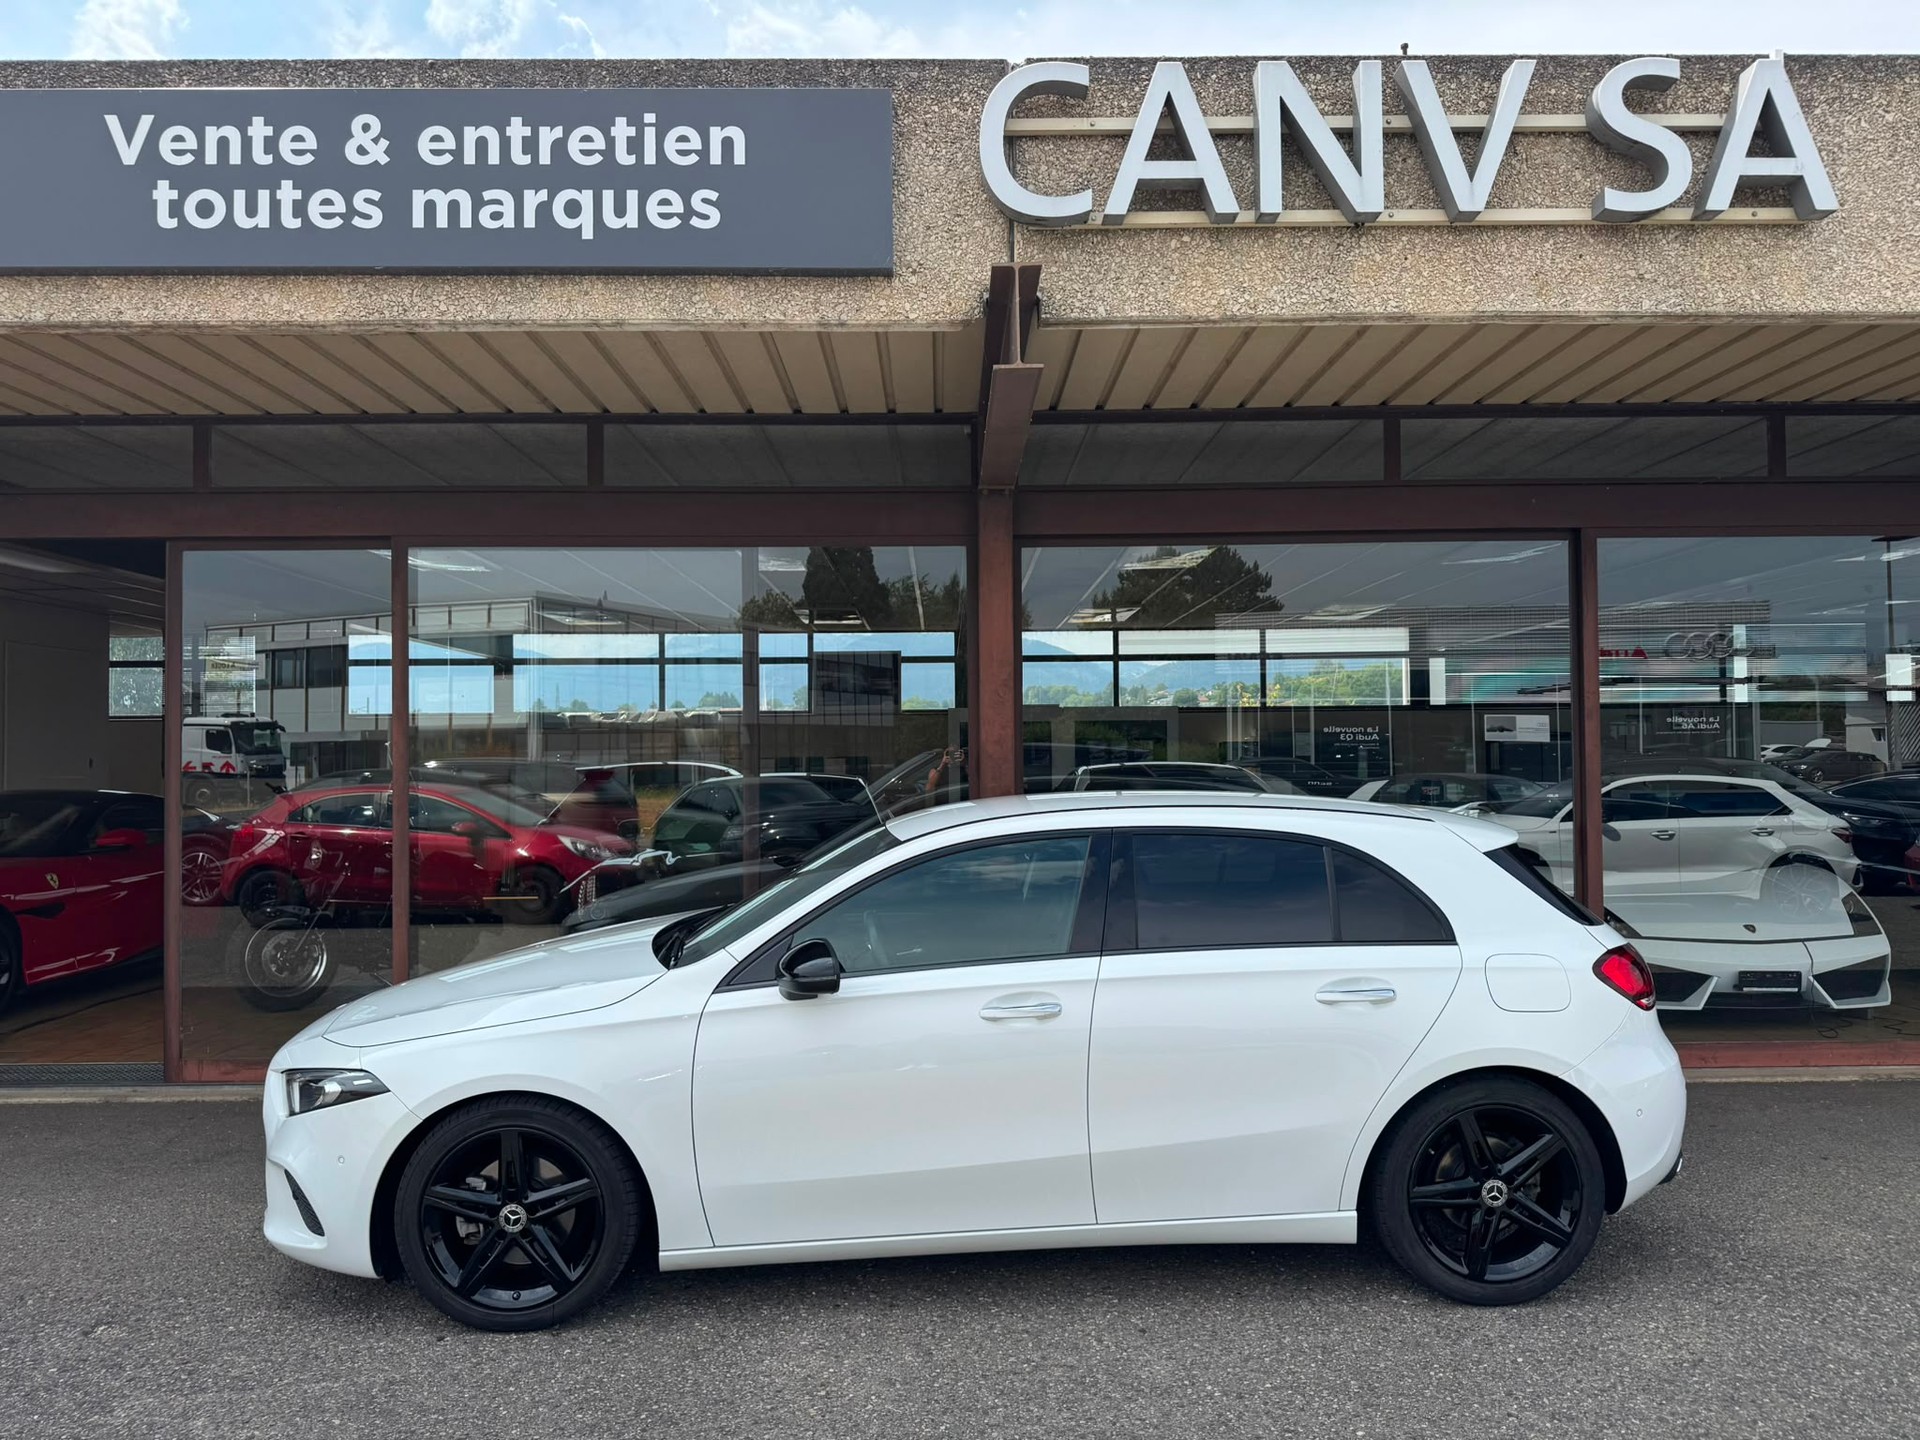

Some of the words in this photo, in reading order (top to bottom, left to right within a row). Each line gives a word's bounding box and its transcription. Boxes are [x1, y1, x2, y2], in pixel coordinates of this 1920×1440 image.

[103, 113, 318, 166] Vente
[344, 113, 391, 166] &
[417, 112, 747, 166] entretien
[979, 58, 1537, 228] CANV
[1585, 50, 1840, 223] SA
[152, 179, 383, 230] toutes
[412, 188, 721, 240] marques
